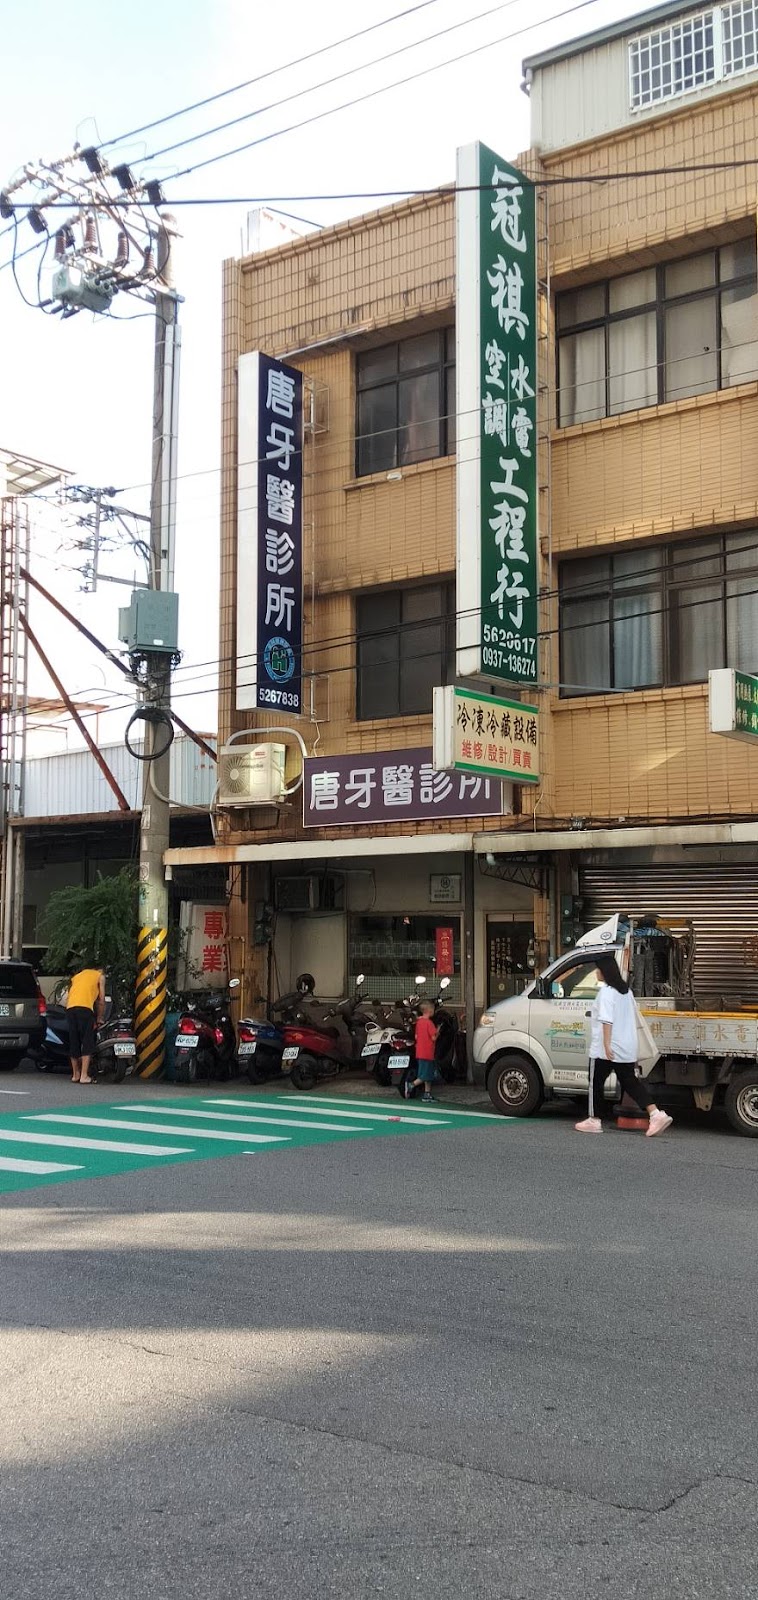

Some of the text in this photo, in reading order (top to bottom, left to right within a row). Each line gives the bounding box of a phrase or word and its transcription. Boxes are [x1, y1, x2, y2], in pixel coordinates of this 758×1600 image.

[486, 164, 529, 341] 冠祺
[482, 338, 508, 447] 空調
[510, 354, 536, 458] 水電
[265, 368, 296, 632] 唐牙醫診所
[488, 456, 531, 629] 工程行
[482, 646, 536, 677] 0937-136274
[483, 623, 536, 655] 5620617
[259, 687, 299, 707] 5267838
[456, 702, 537, 747] 冷凍冷藏設備
[461, 738, 531, 769] 維修/設計/買賣
[202, 911, 224, 972] 專業
